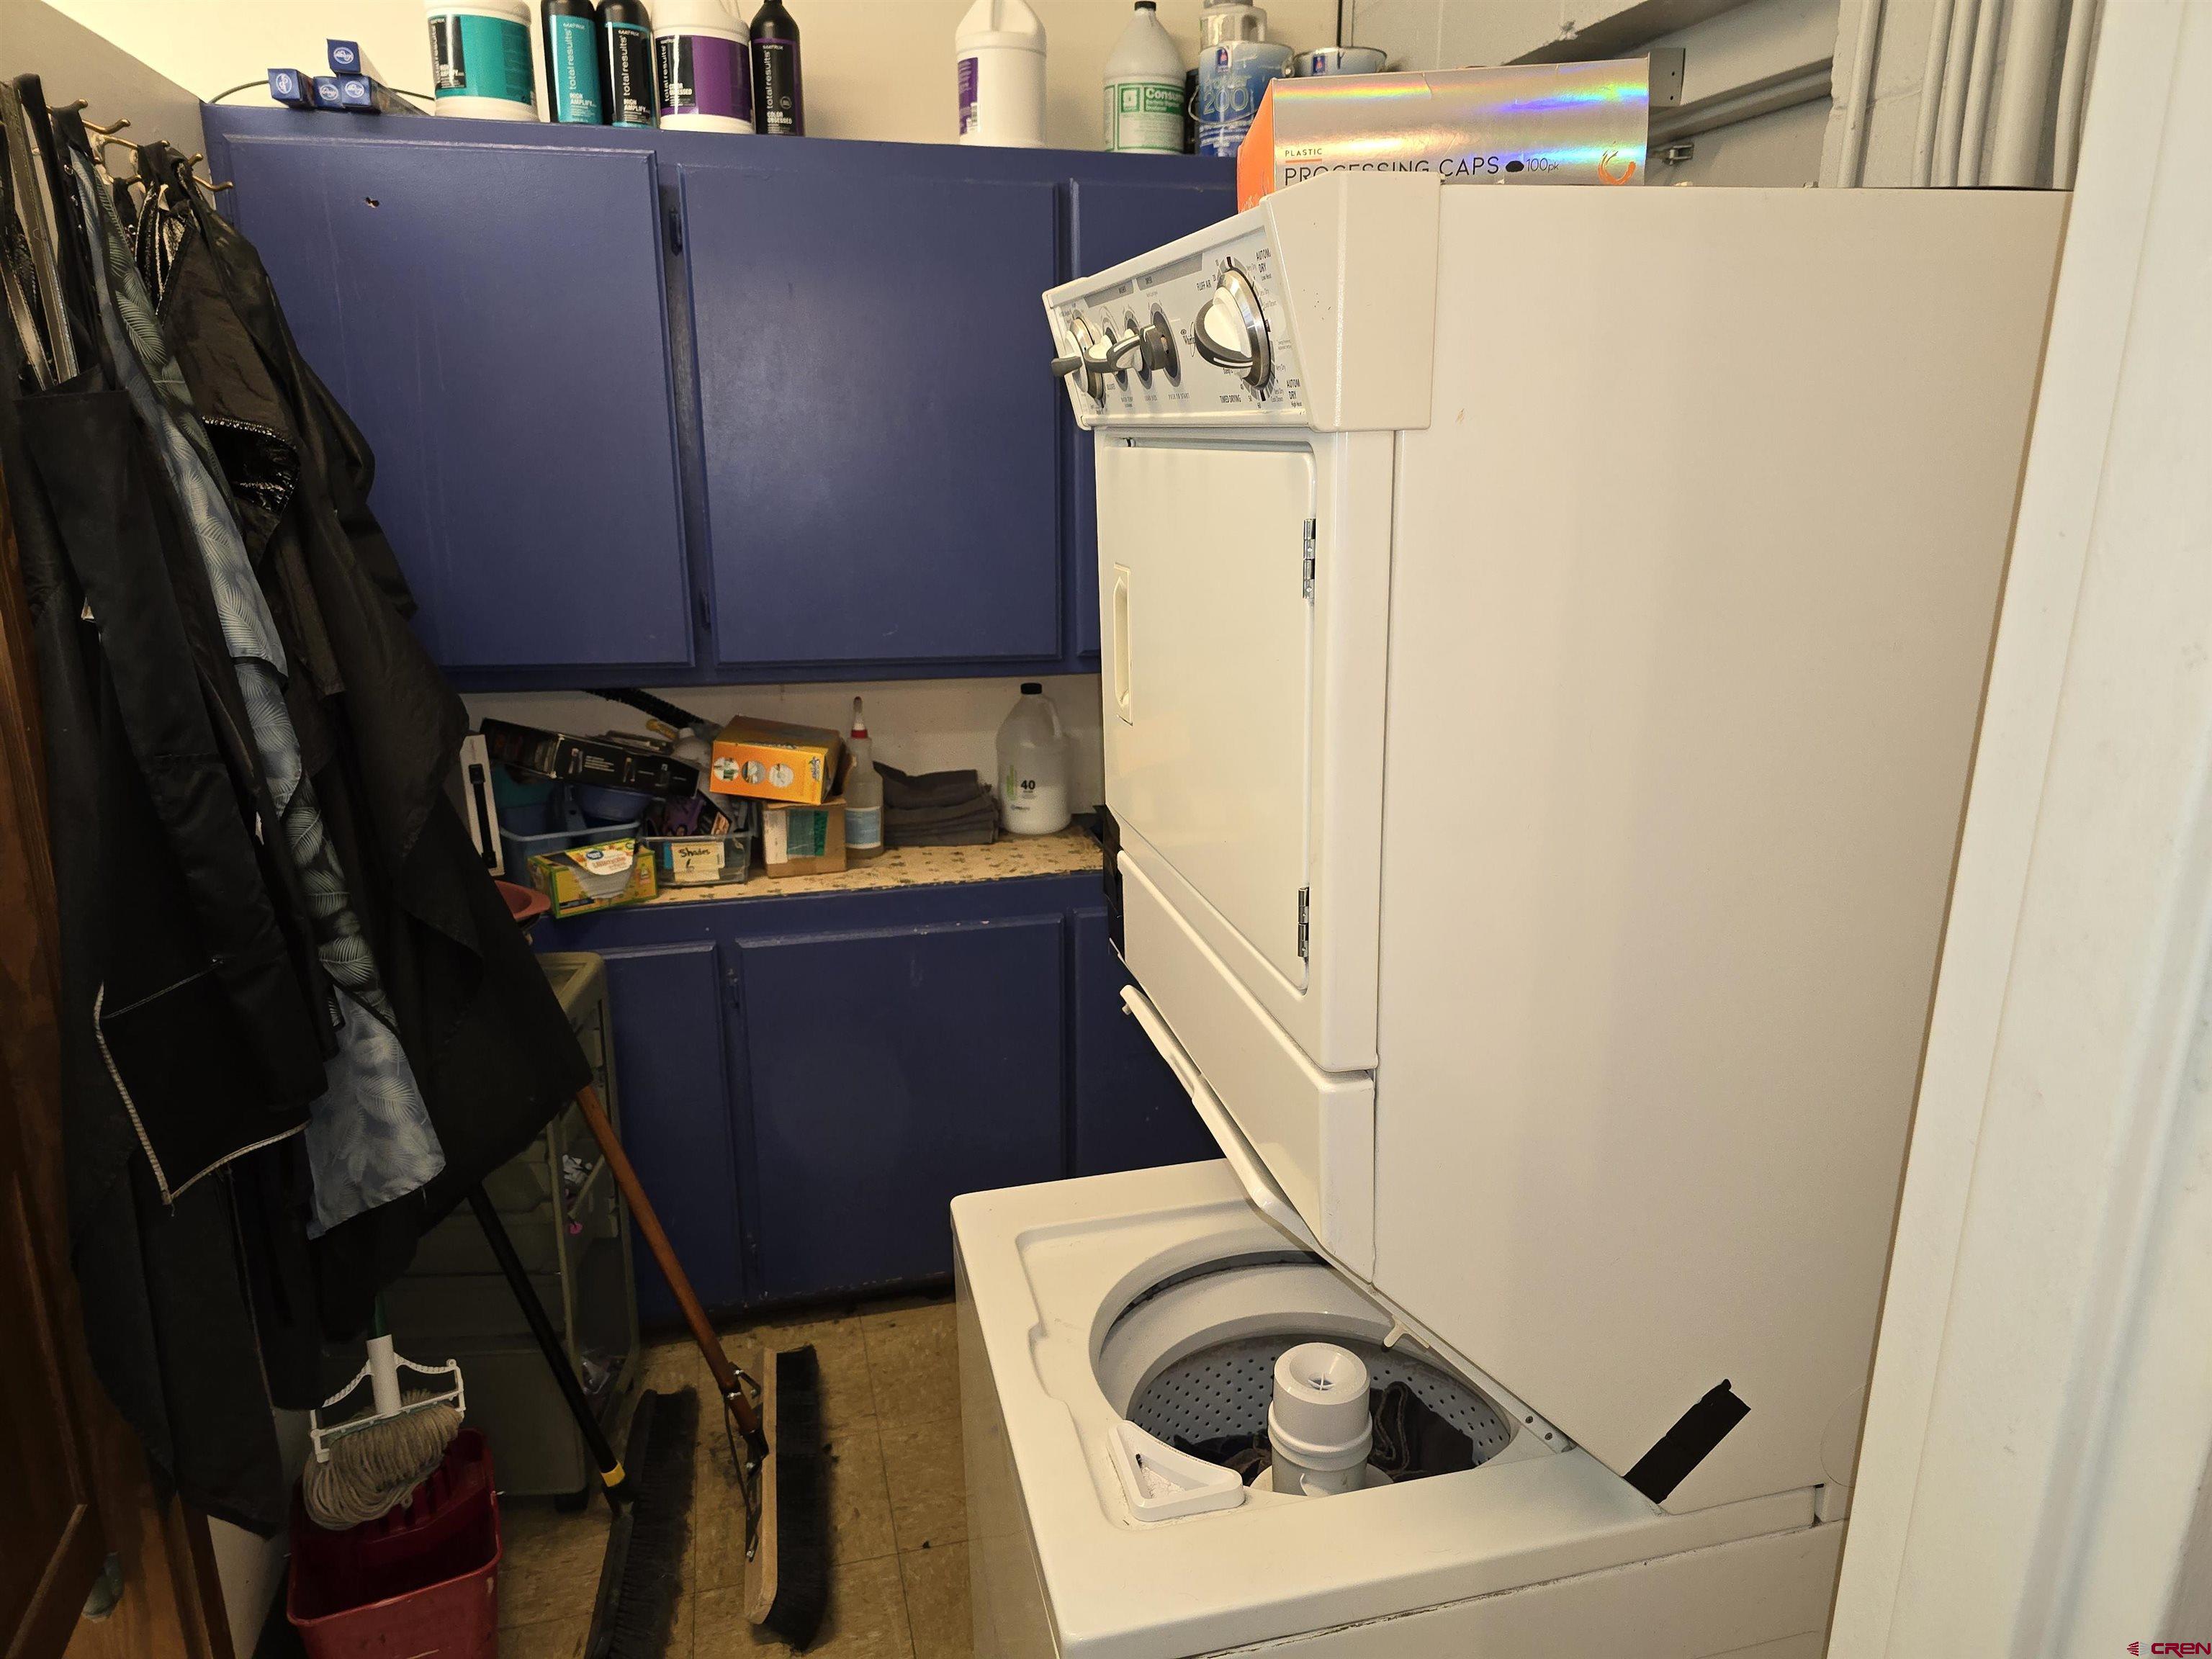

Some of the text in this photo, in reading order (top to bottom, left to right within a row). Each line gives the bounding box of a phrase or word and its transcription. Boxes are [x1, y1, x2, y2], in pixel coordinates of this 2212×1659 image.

[1203, 87, 1249, 114] 200
[1285, 148, 1323, 157] PLASTIC
[1439, 156, 1499, 176] CAPS
[1020, 779, 1036, 791] 40
